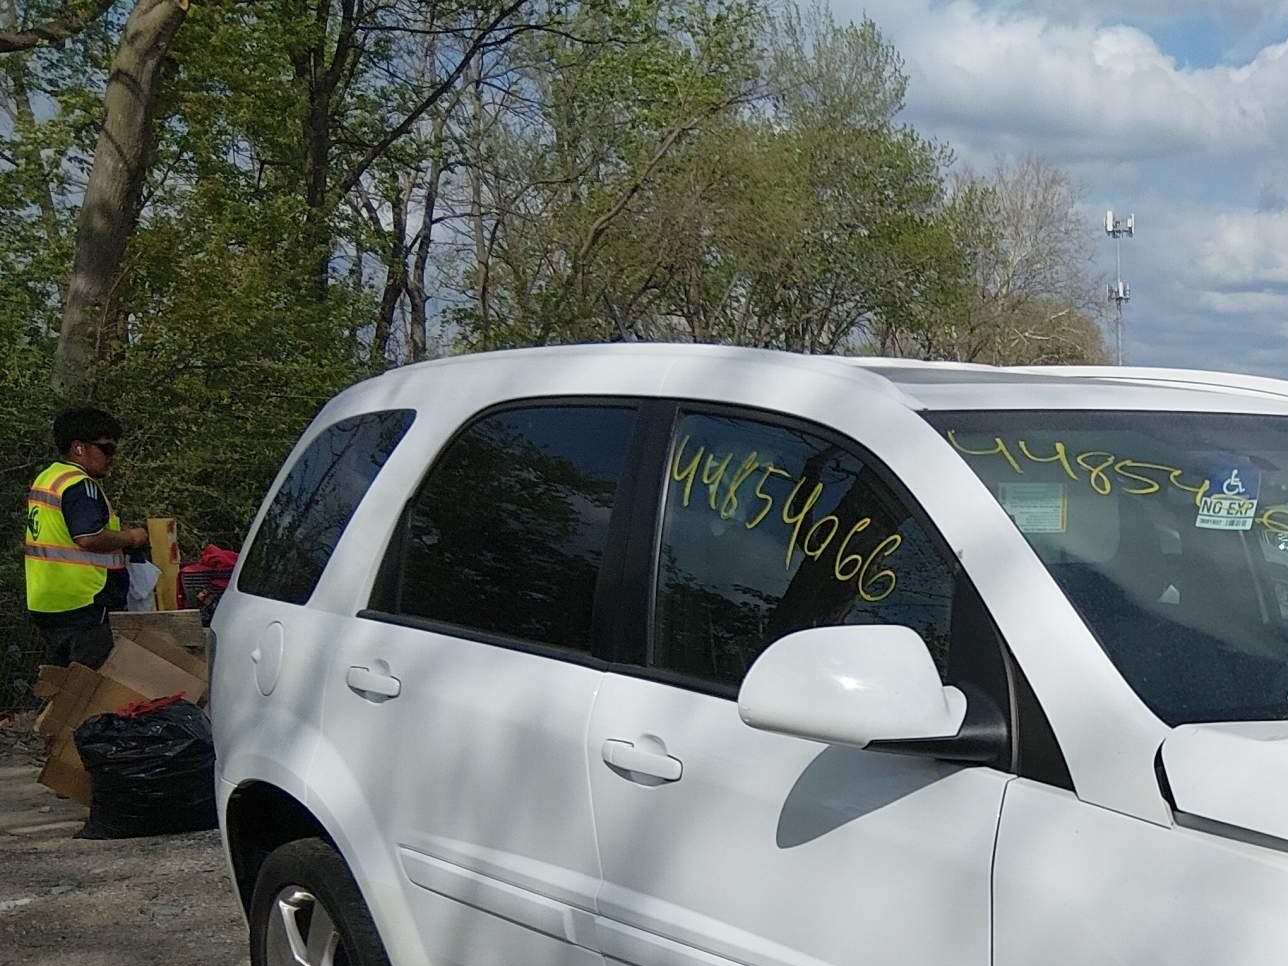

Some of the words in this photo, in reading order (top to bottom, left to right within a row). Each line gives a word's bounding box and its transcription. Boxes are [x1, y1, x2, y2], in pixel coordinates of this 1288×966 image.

[671, 434, 902, 602] 44854066
[1201, 500, 1223, 515] NO
[1226, 502, 1255, 517] EXP
